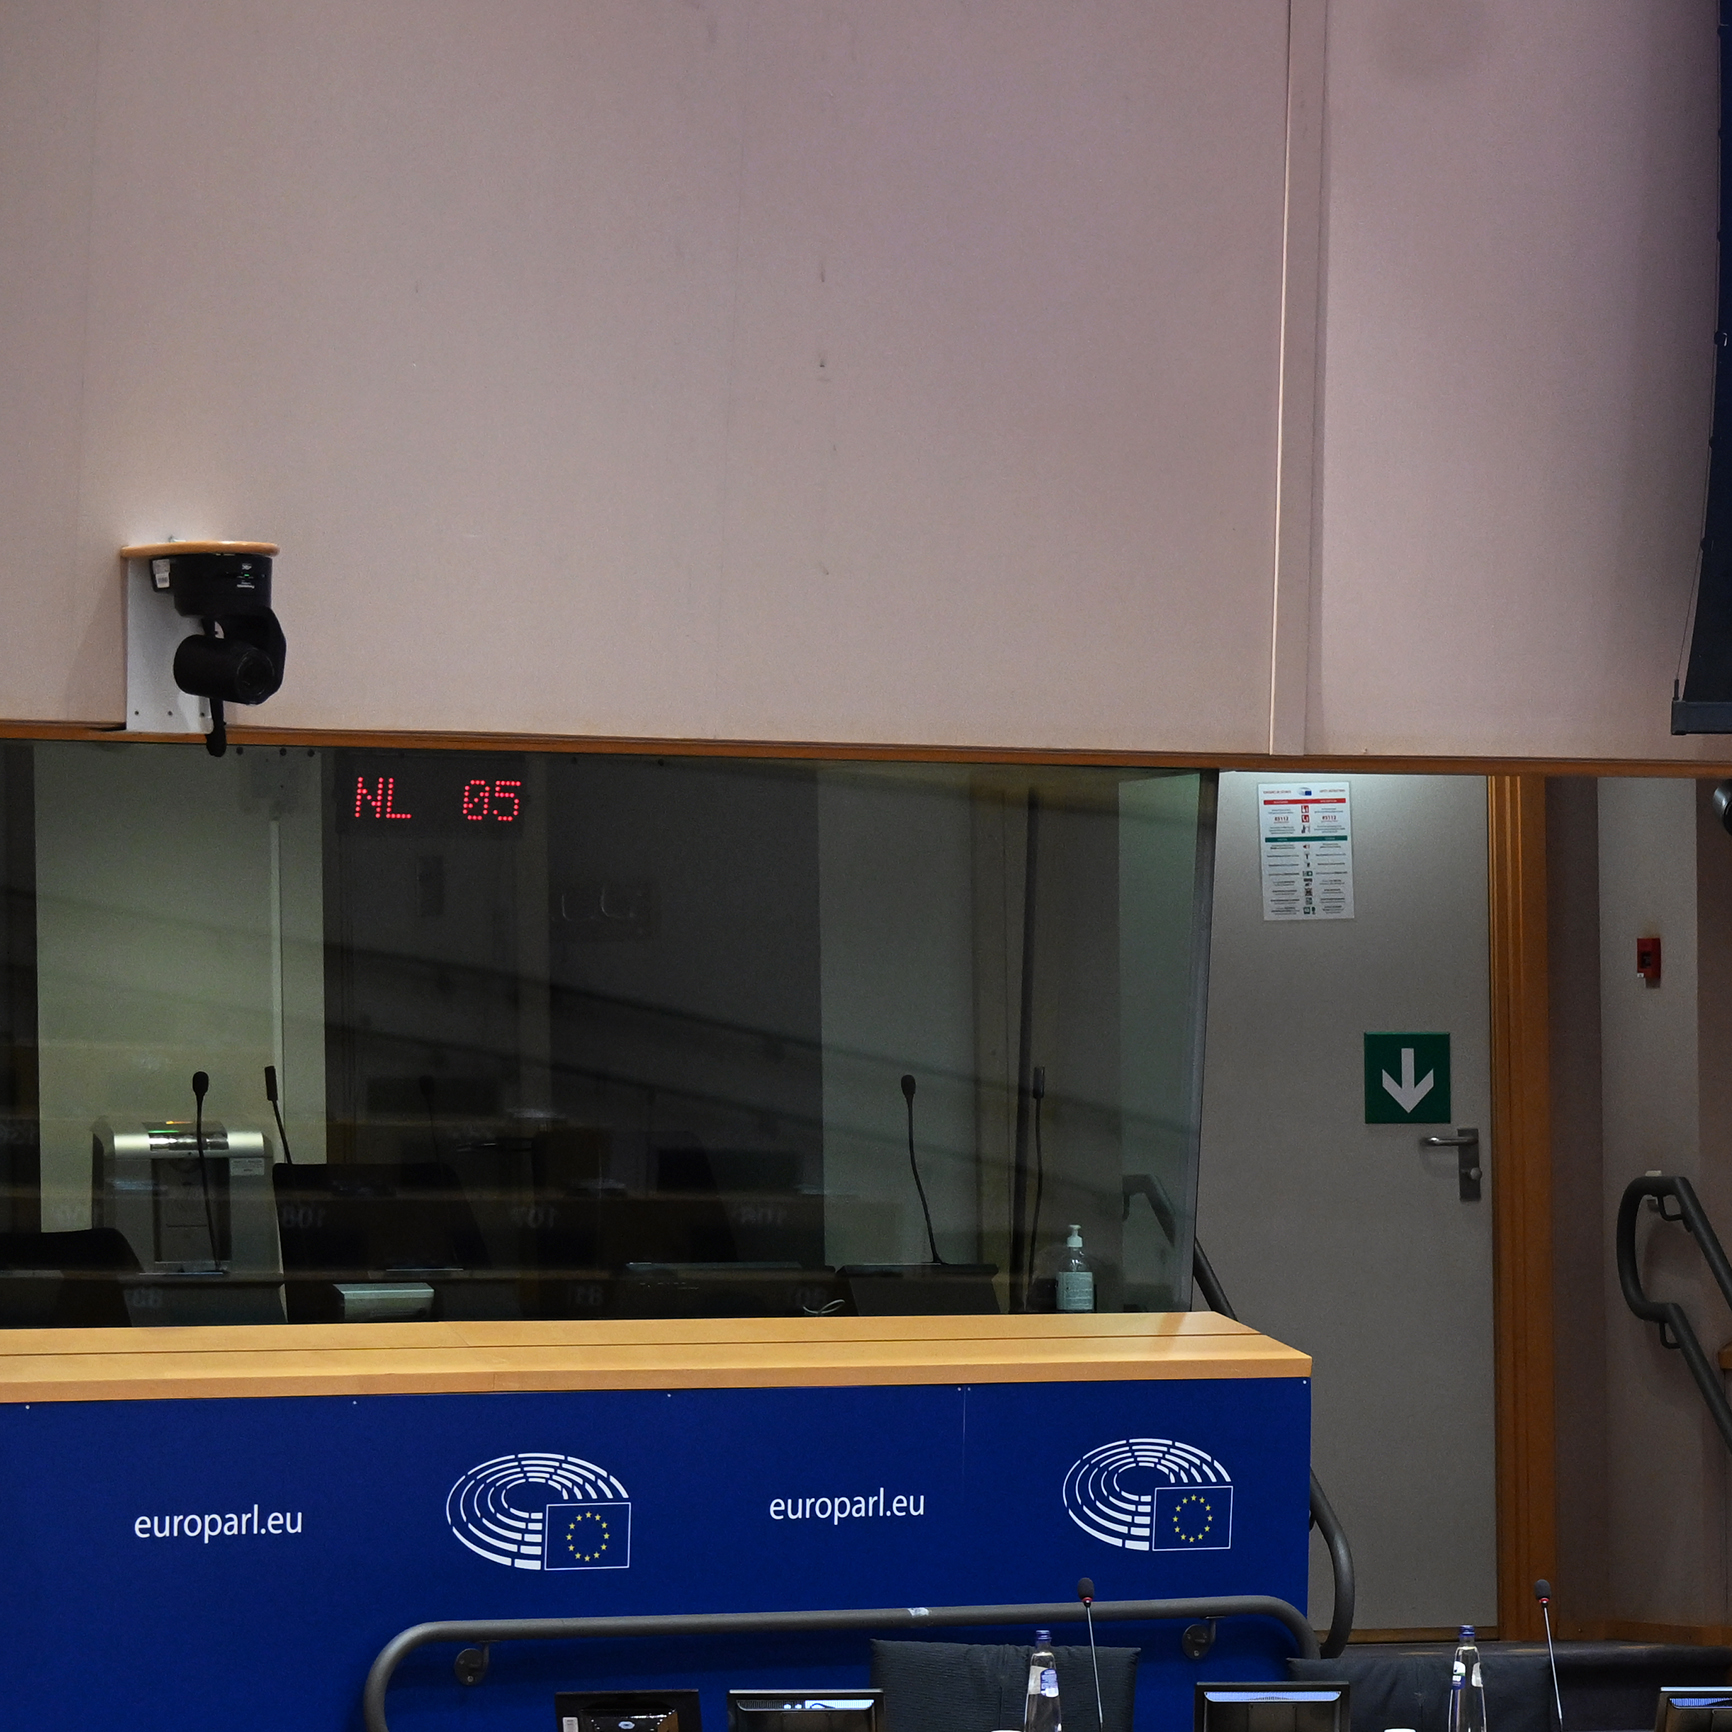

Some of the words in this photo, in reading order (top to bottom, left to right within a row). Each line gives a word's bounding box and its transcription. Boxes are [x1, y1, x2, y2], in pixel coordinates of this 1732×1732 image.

[355, 776, 412, 819] NL
[462, 779, 521, 822] 05
[134, 1504, 303, 1544] europarl.eu
[769, 1488, 926, 1526] europarl.eu
